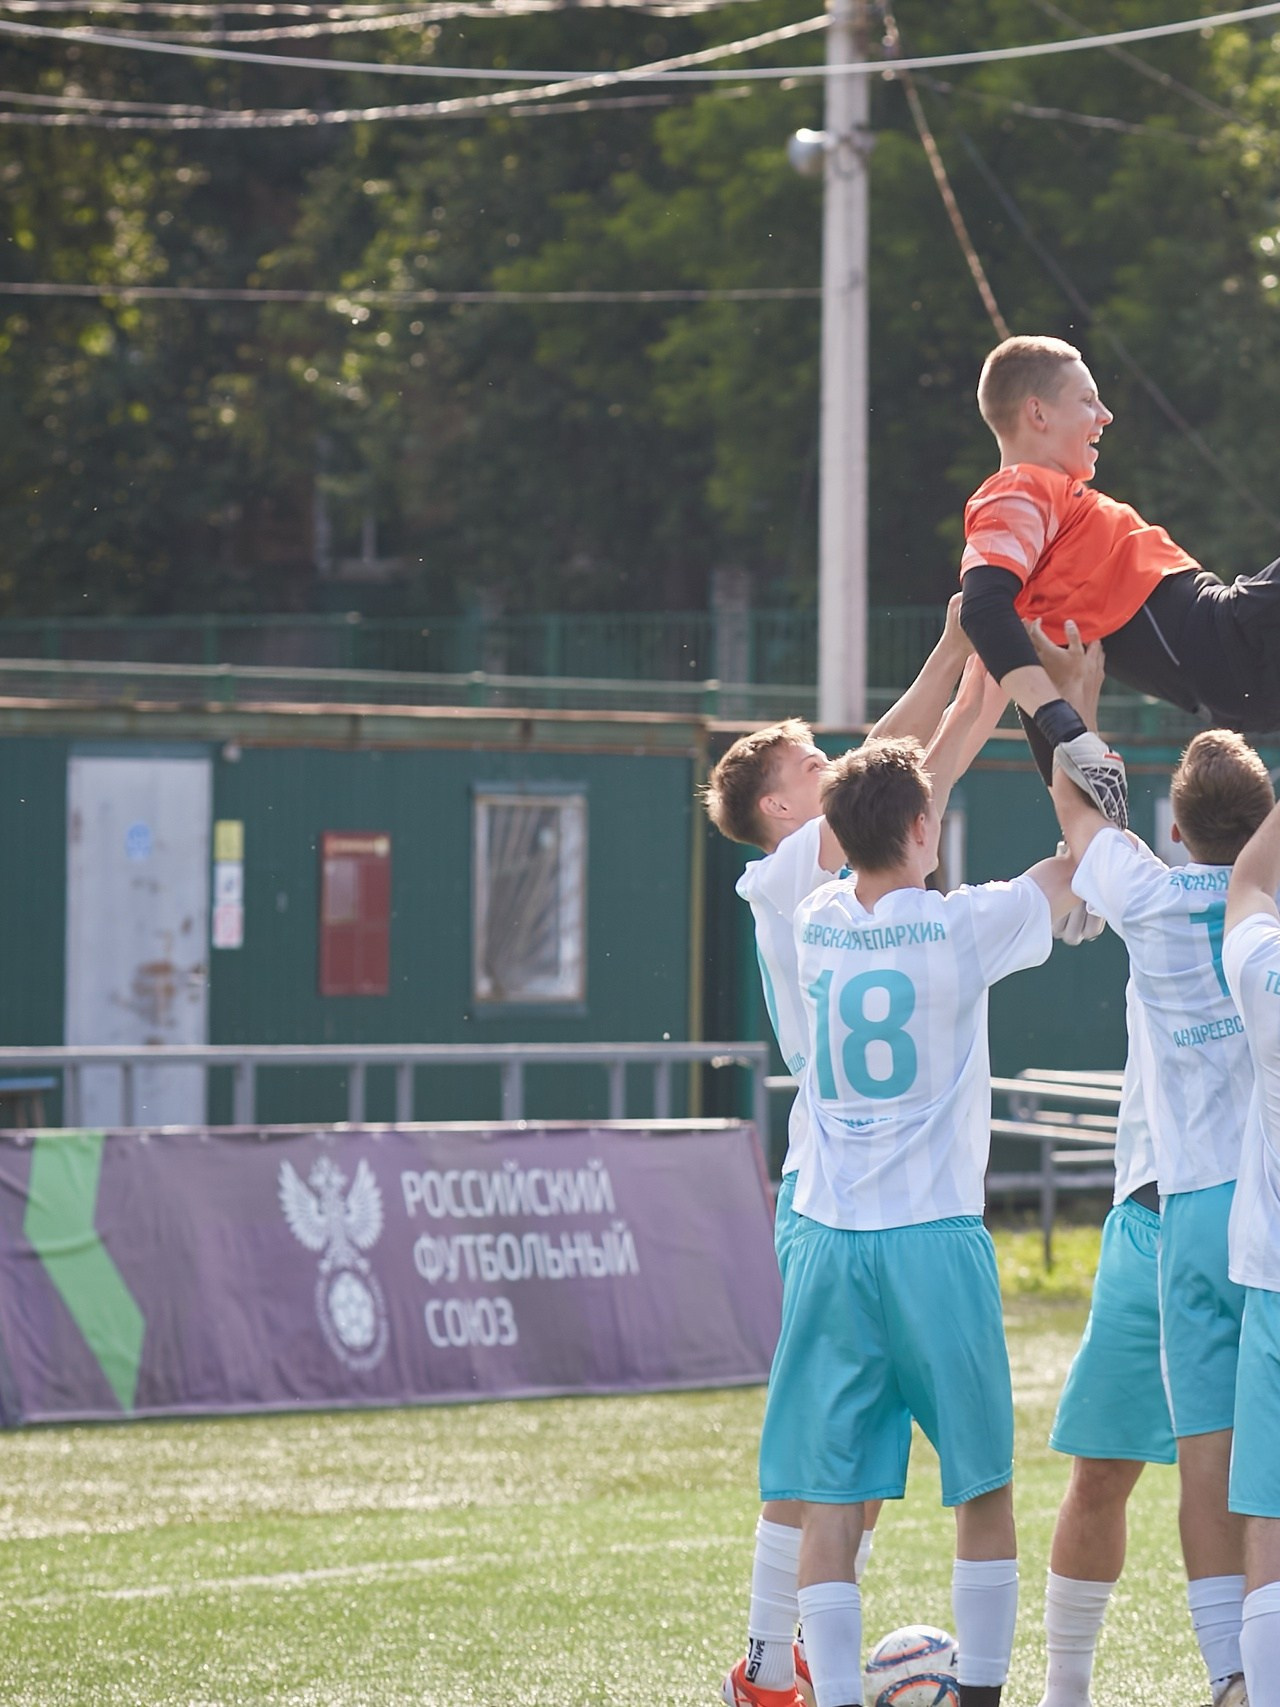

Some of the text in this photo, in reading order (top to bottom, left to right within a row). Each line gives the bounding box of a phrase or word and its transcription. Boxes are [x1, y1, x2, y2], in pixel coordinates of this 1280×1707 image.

[863, 921, 946, 950] ЕПАРХИЯ
[808, 969, 918, 1100] 18
[402, 1158, 615, 1219] РОССИЙСКИЙ
[413, 1219, 640, 1284] ФУТБОЛЬНЫЙ
[425, 1297, 519, 1348] СОЮЗ
